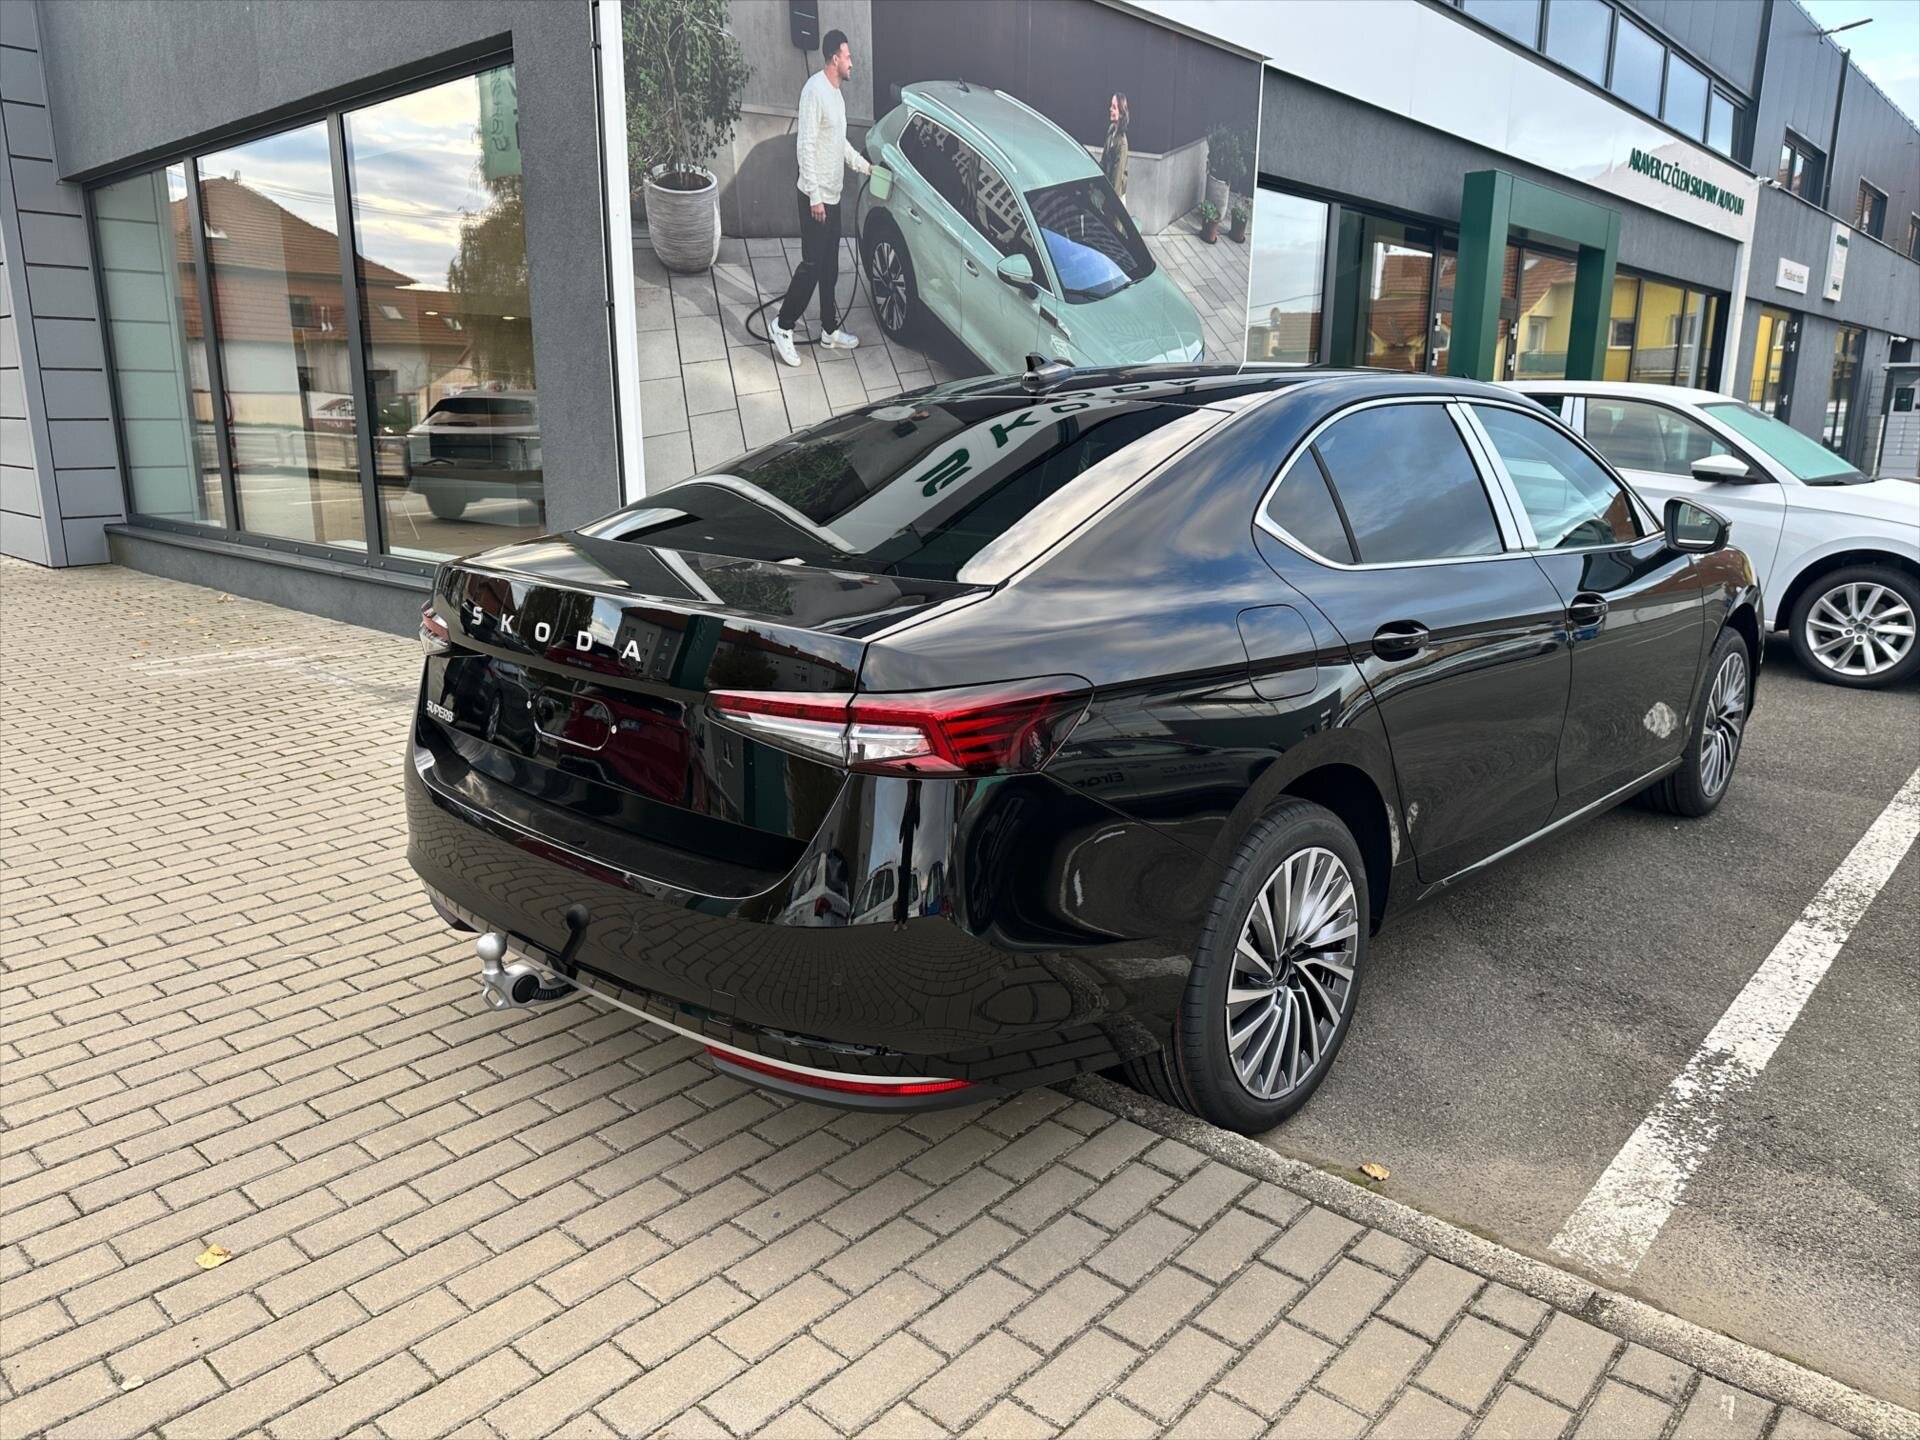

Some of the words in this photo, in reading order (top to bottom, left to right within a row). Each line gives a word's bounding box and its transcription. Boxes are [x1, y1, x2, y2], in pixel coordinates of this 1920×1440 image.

[1628, 147, 1661, 180] ARAVER
[1661, 163, 1672, 186] CZ
[1672, 162, 1691, 193] ČLEN
[426, 699, 454, 723] SUPERB
